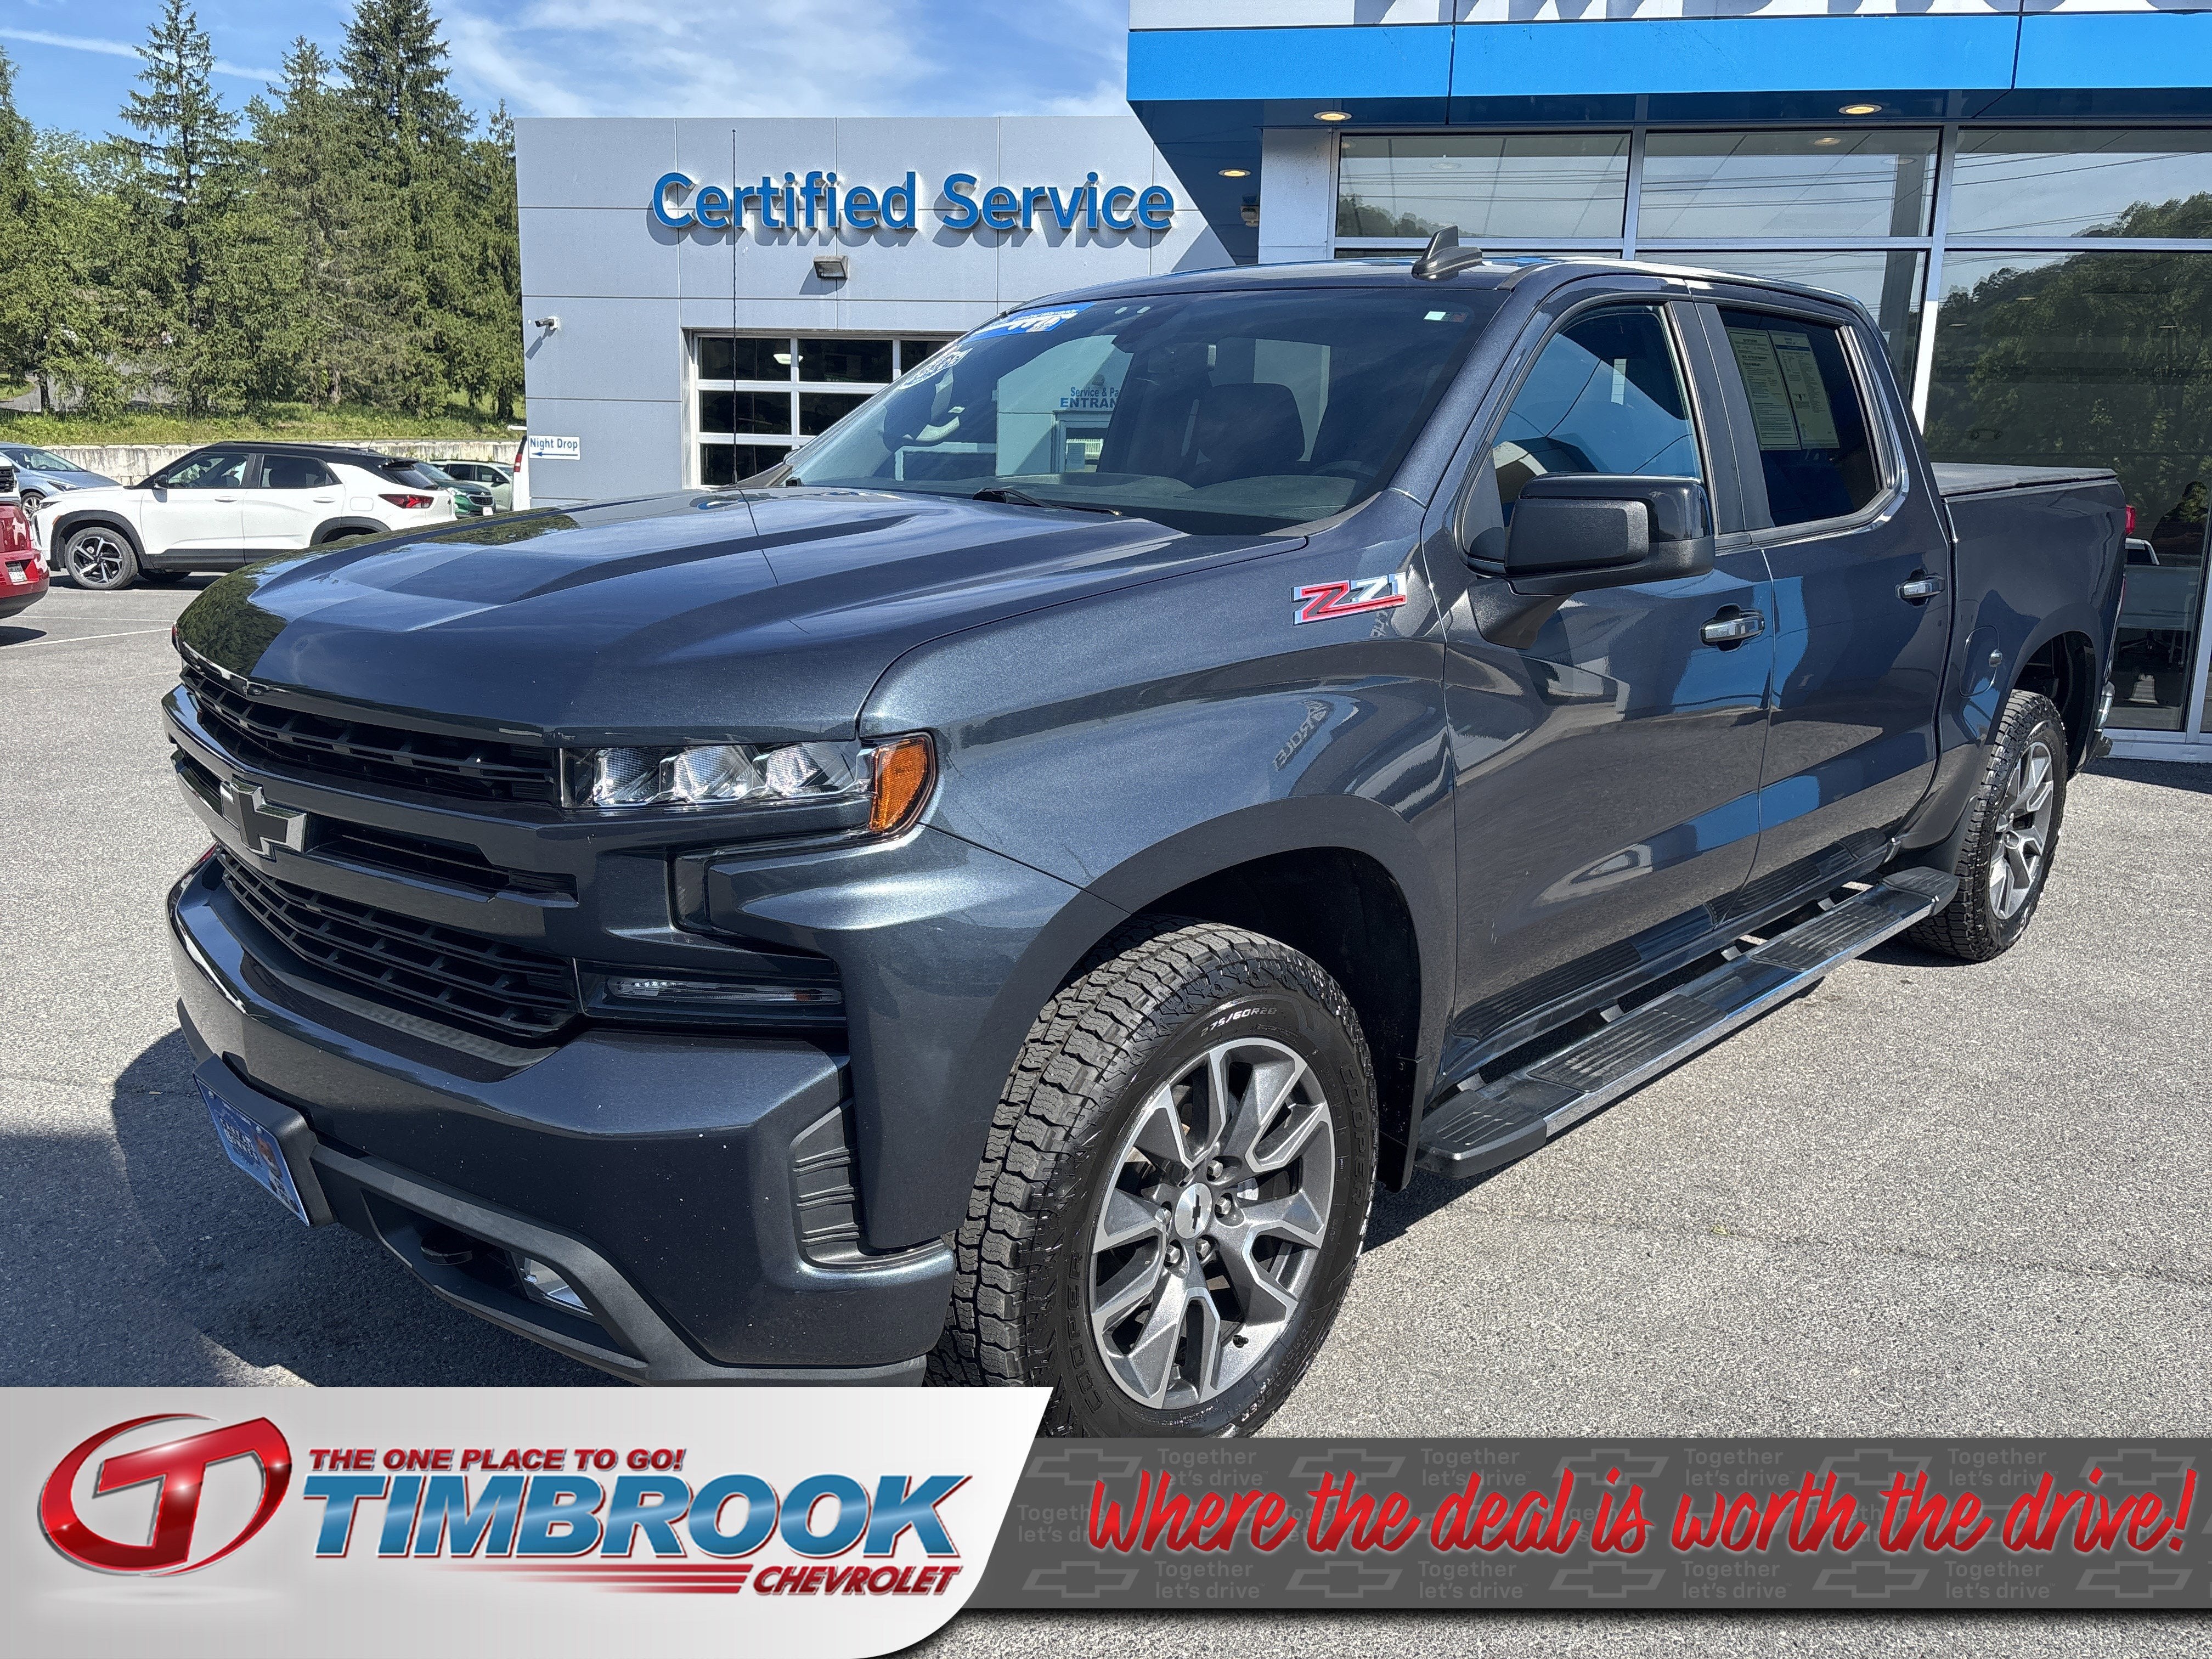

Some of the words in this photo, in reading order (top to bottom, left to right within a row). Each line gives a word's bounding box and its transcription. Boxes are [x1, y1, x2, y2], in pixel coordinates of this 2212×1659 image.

[652, 171, 916, 229] Certified
[941, 171, 1175, 230] Service
[1070, 386, 1101, 397] Service
[1101, 387, 1107, 397] &
[530, 437, 554, 450] Night
[557, 438, 578, 452] Drop
[1291, 572, 1407, 626] Z71
[1199, 1007, 1277, 1037] 275/60R20
[1340, 1064, 1366, 1207] COOPER
[1067, 1252, 1103, 1413] COOPER
